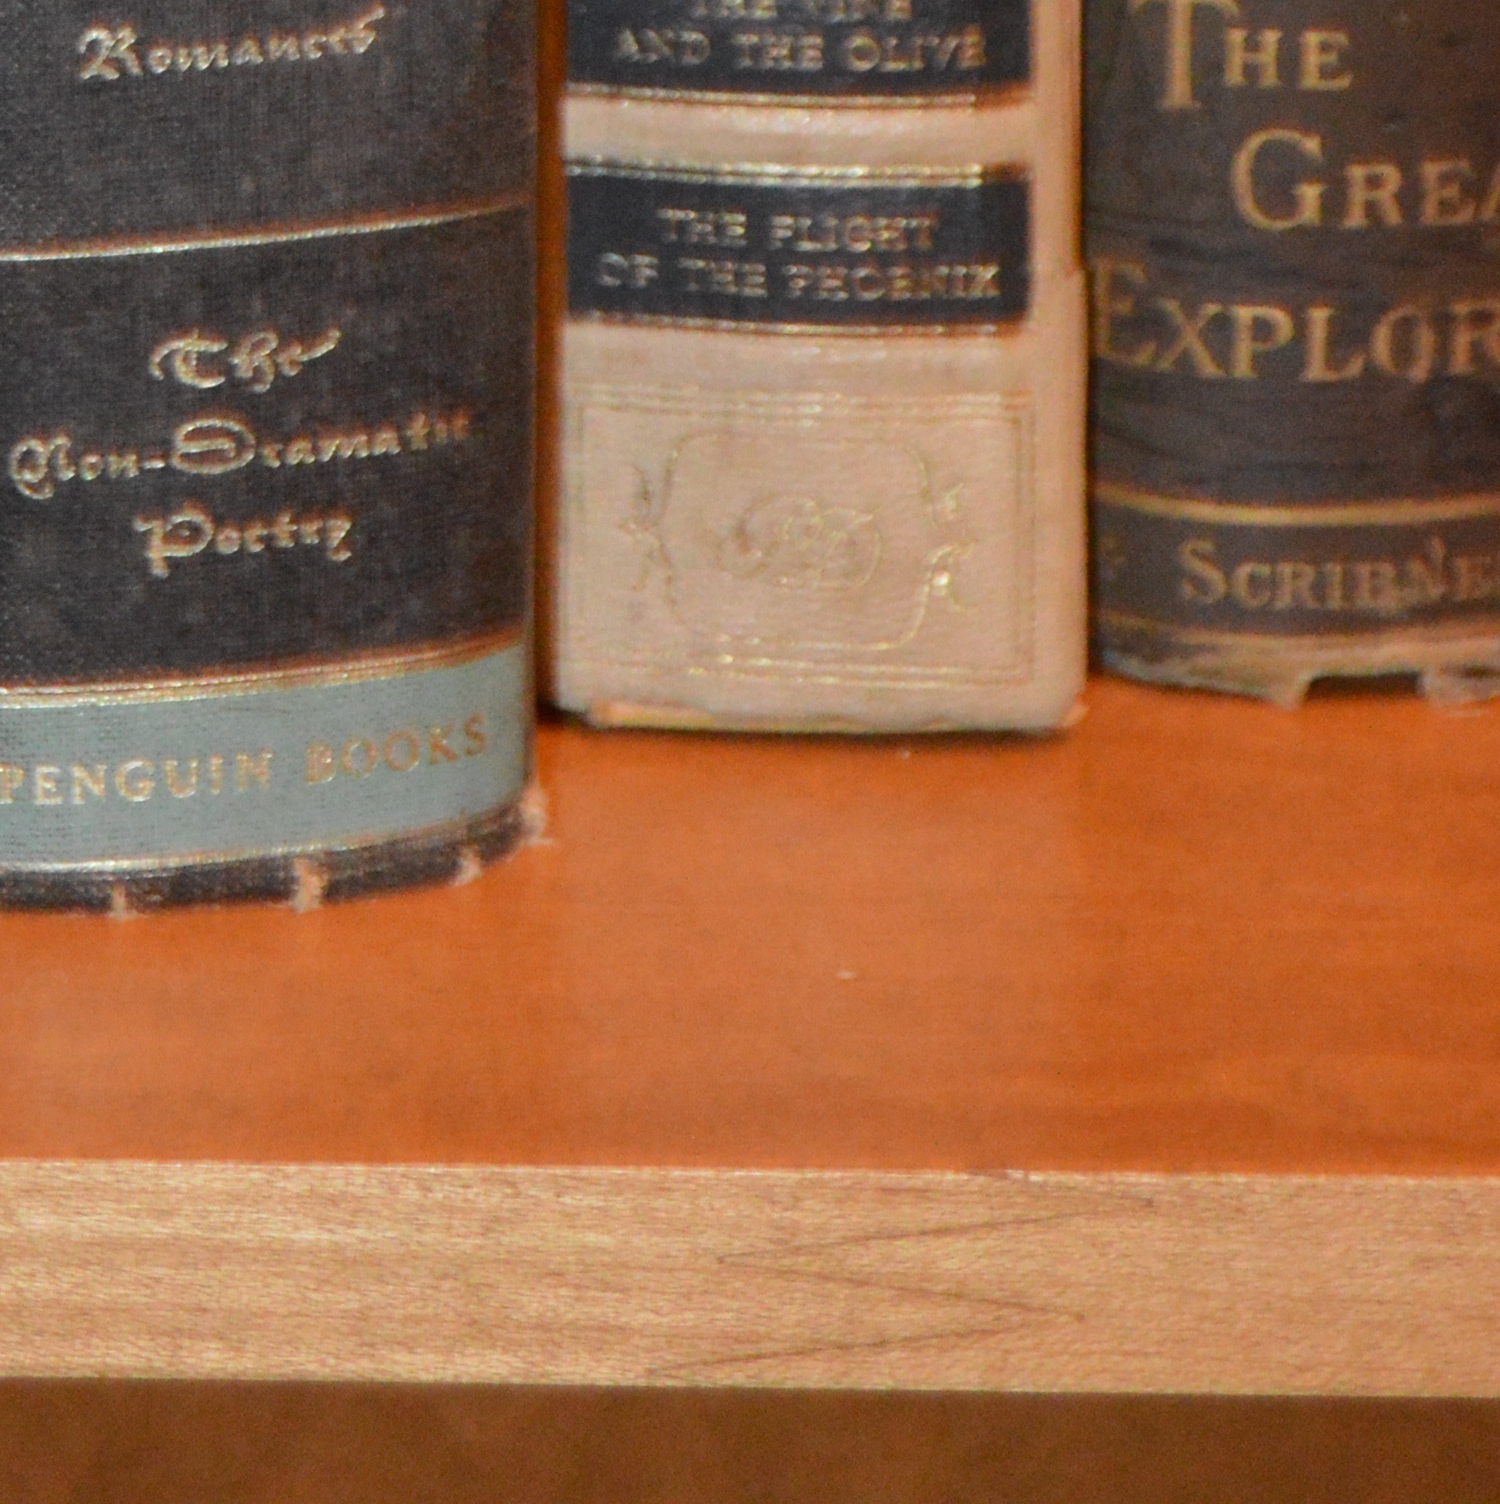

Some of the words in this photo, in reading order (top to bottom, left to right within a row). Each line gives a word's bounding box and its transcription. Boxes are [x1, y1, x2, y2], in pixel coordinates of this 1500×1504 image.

[1230, 125, 1500, 232] GRE
[149, 327, 343, 393] The
[305, 711, 491, 786] BOOKS
